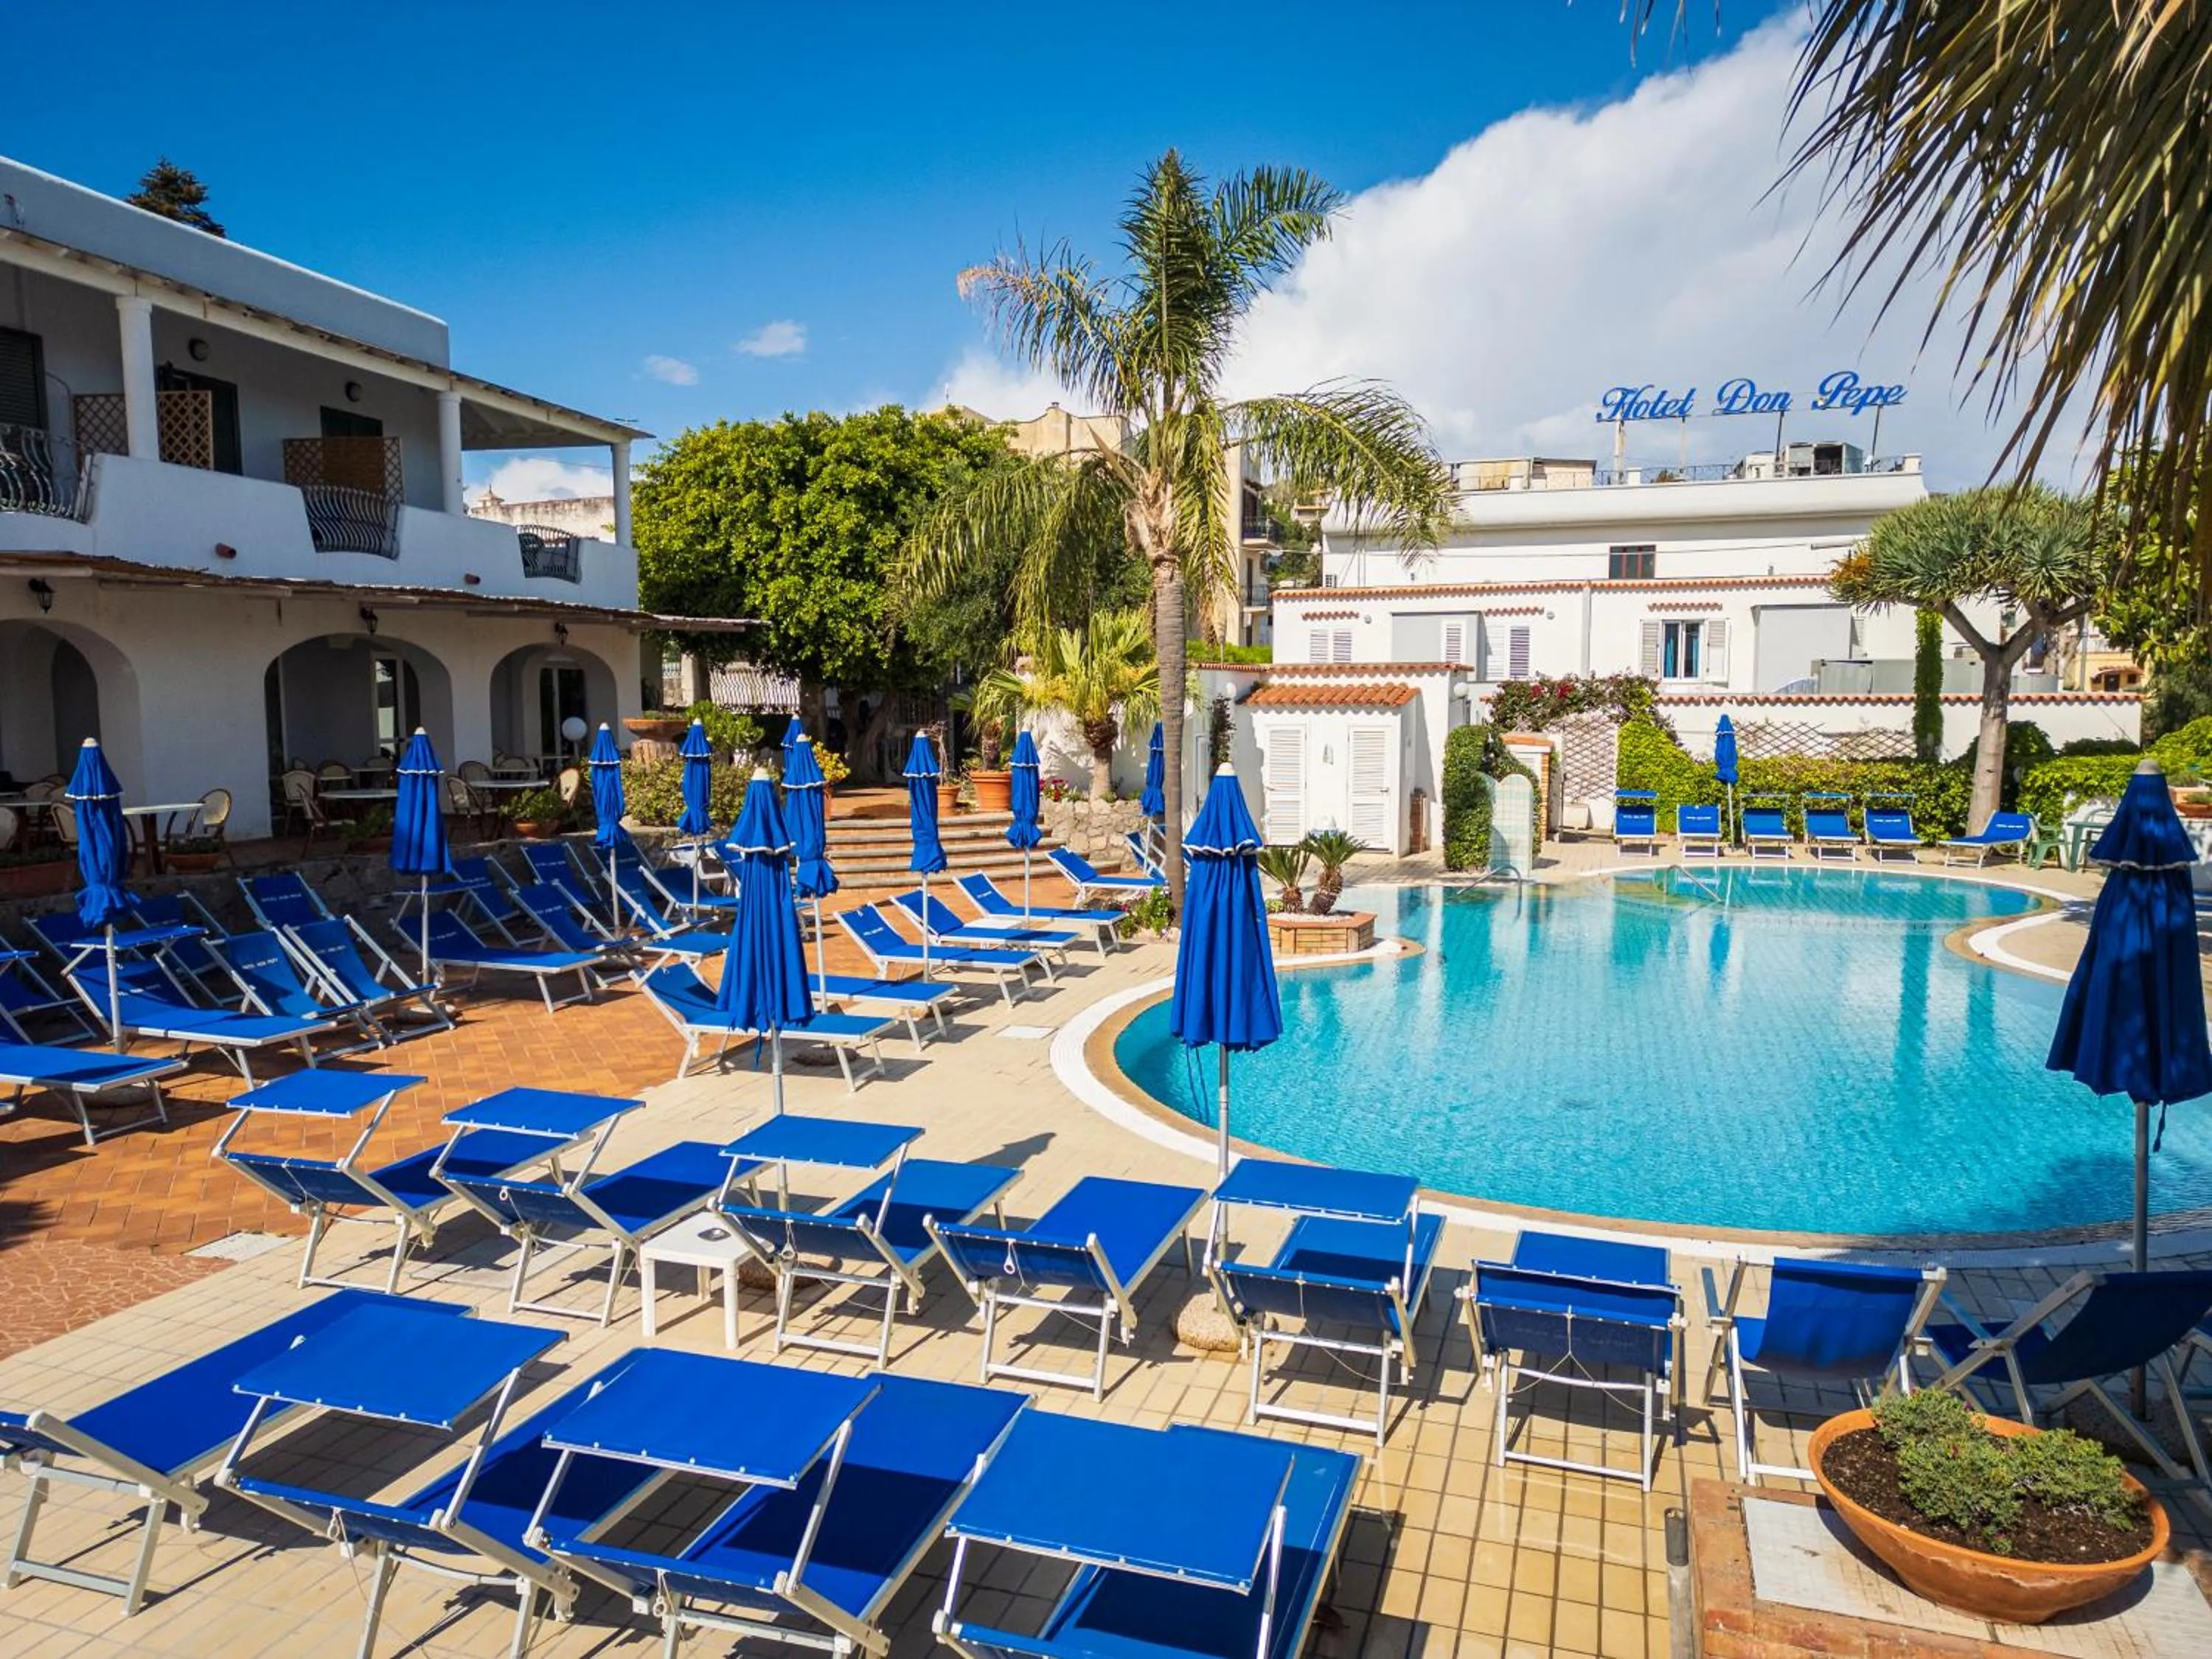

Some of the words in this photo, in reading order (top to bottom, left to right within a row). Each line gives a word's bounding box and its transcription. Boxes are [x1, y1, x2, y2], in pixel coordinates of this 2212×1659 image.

[1596, 384, 1697, 420] Hotel
[1712, 378, 1793, 415] Don
[1811, 371, 1908, 415] Pepe
